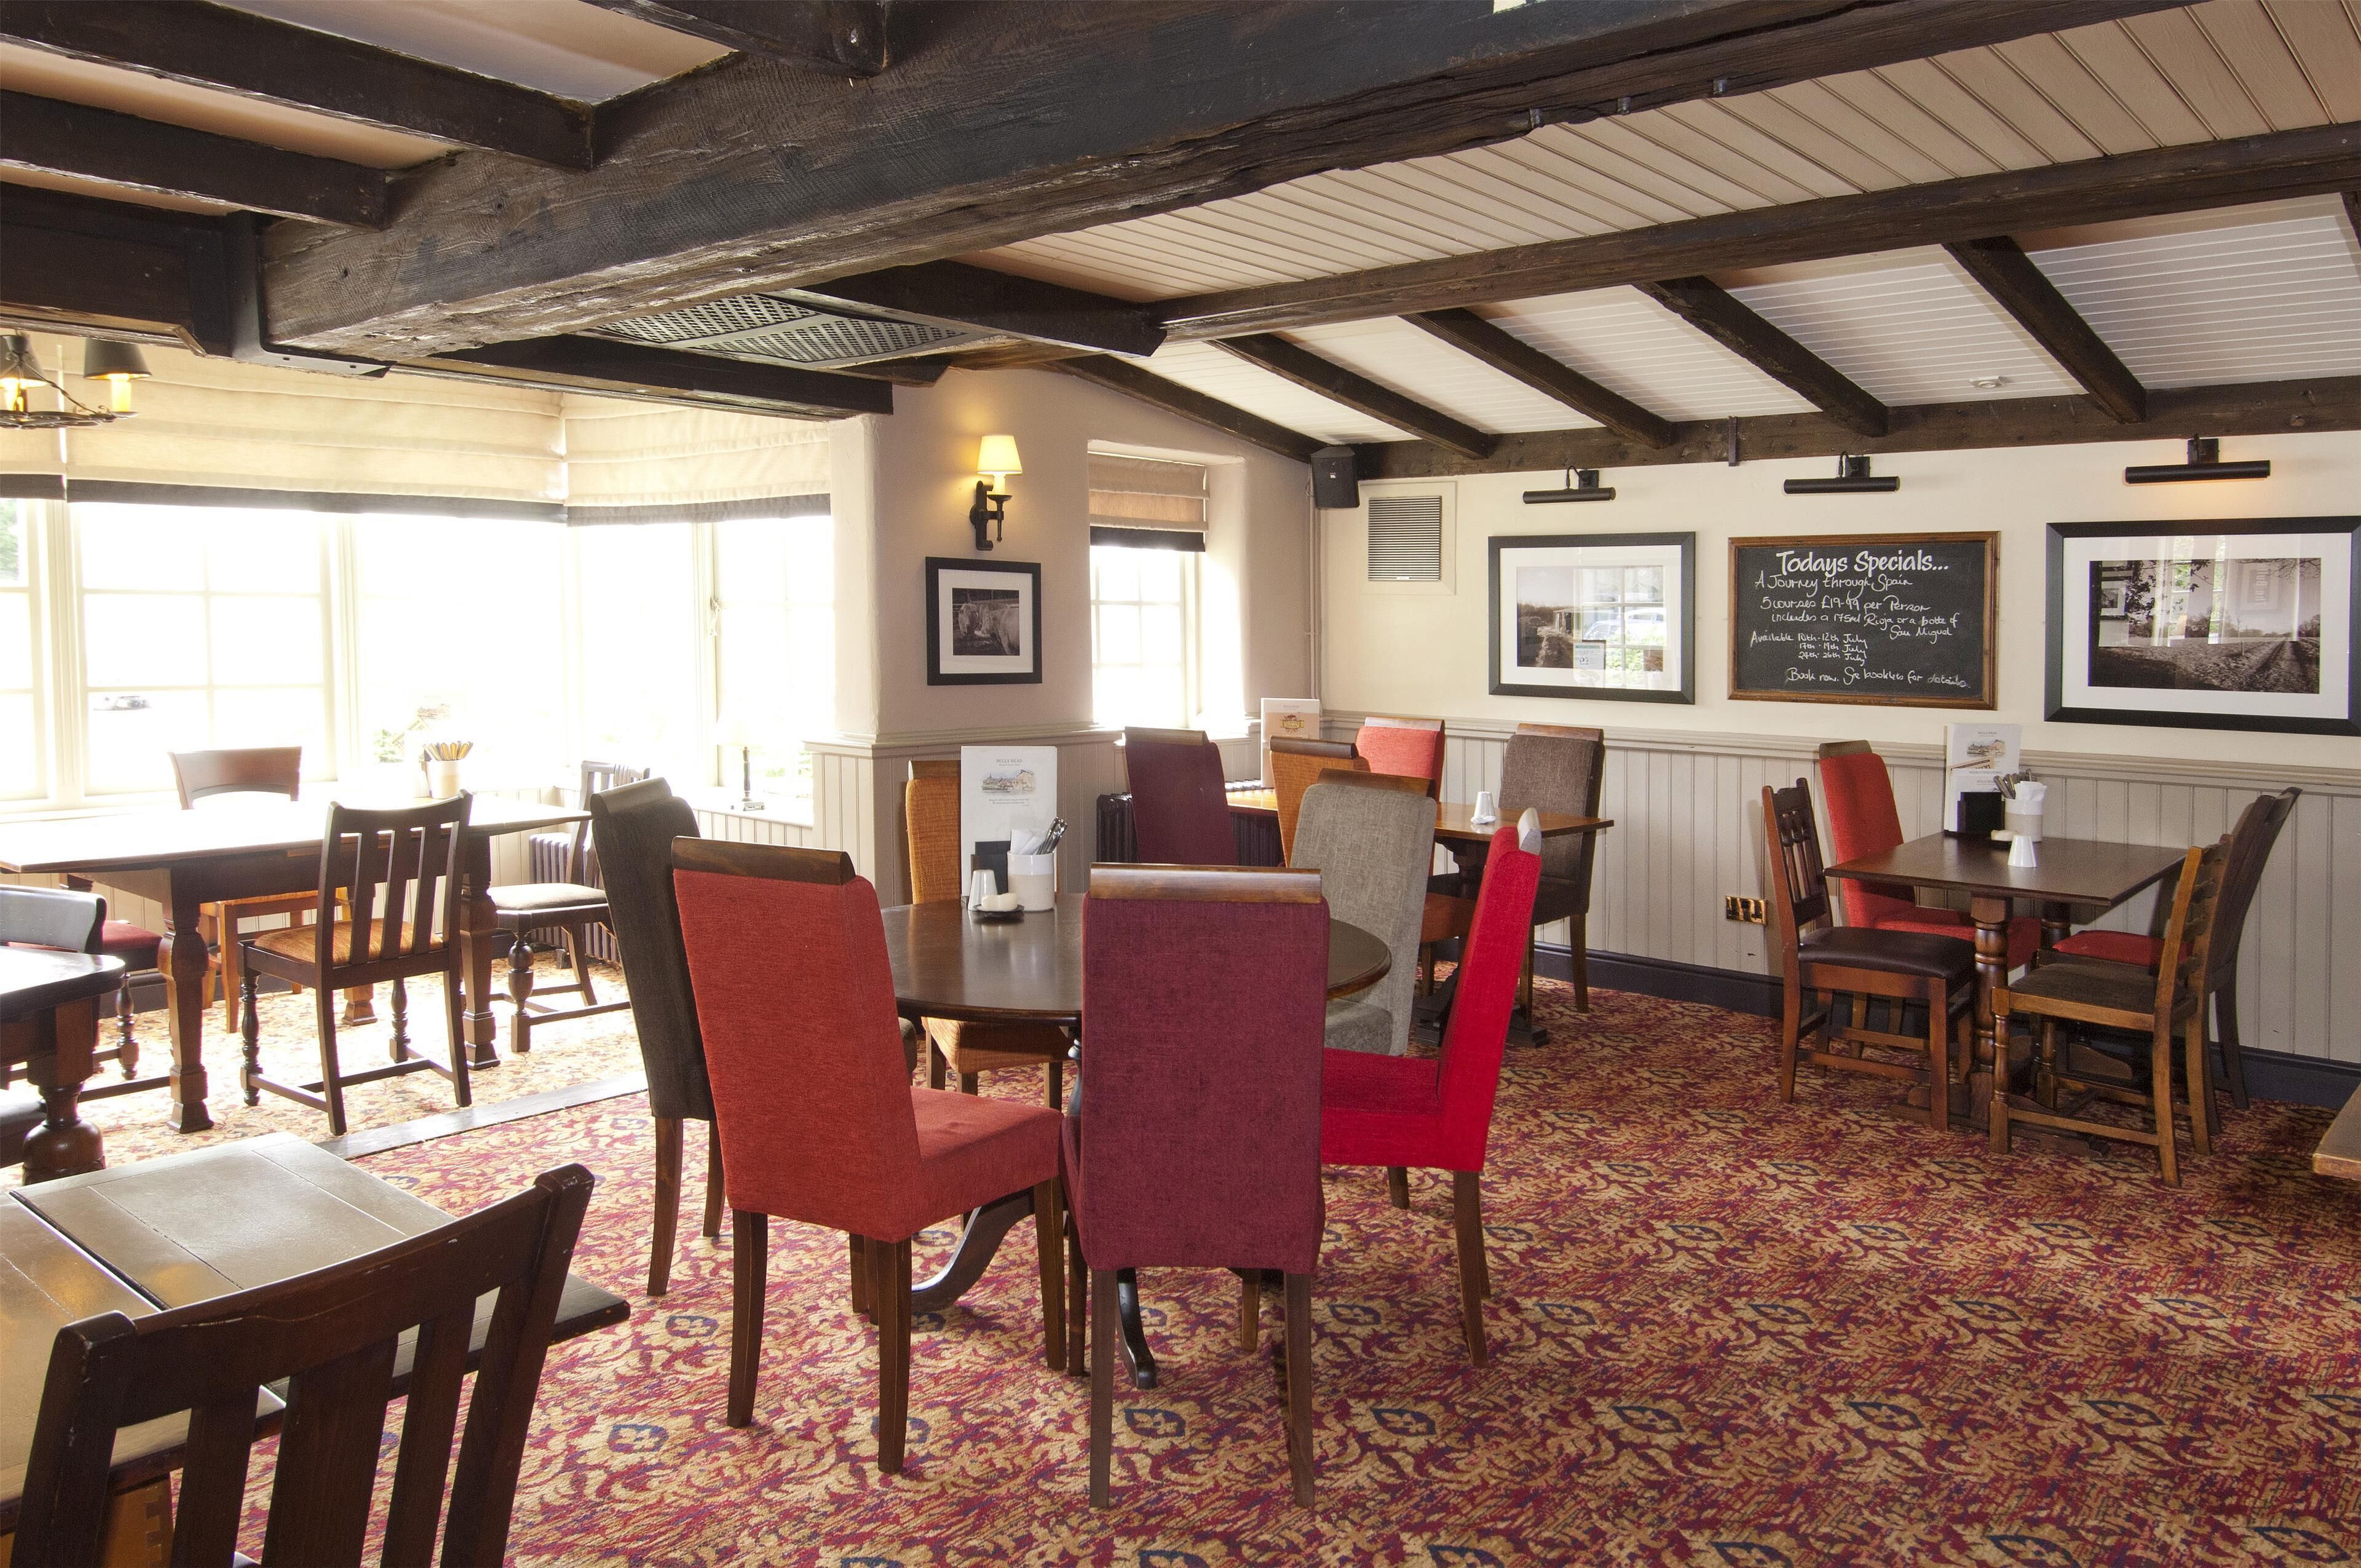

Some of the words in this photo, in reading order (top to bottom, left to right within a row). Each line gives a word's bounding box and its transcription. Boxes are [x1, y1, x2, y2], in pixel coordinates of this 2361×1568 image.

[1776, 550, 1848, 577] Todays
[1854, 550, 1948, 577] Specials...
[1755, 570, 1764, 589] A
[1767, 574, 1818, 598] Journey
[1823, 575, 1871, 600] through
[1871, 574, 1913, 592] Spain
[1864, 602, 1881, 614] per
[1771, 609, 1816, 622] includes
[1864, 613, 1893, 630] Rioja
[1949, 612, 1960, 628] of
[1750, 630, 1793, 647] Available
[1843, 633, 1868, 649] July
[1889, 625, 1910, 639] San
[1916, 627, 1953, 644] Miguel
[1842, 644, 1867, 659] July
[1844, 653, 1864, 666] July
[1787, 667, 1816, 681] Book
[1843, 667, 1861, 685] See
[1907, 670, 1923, 684] for
